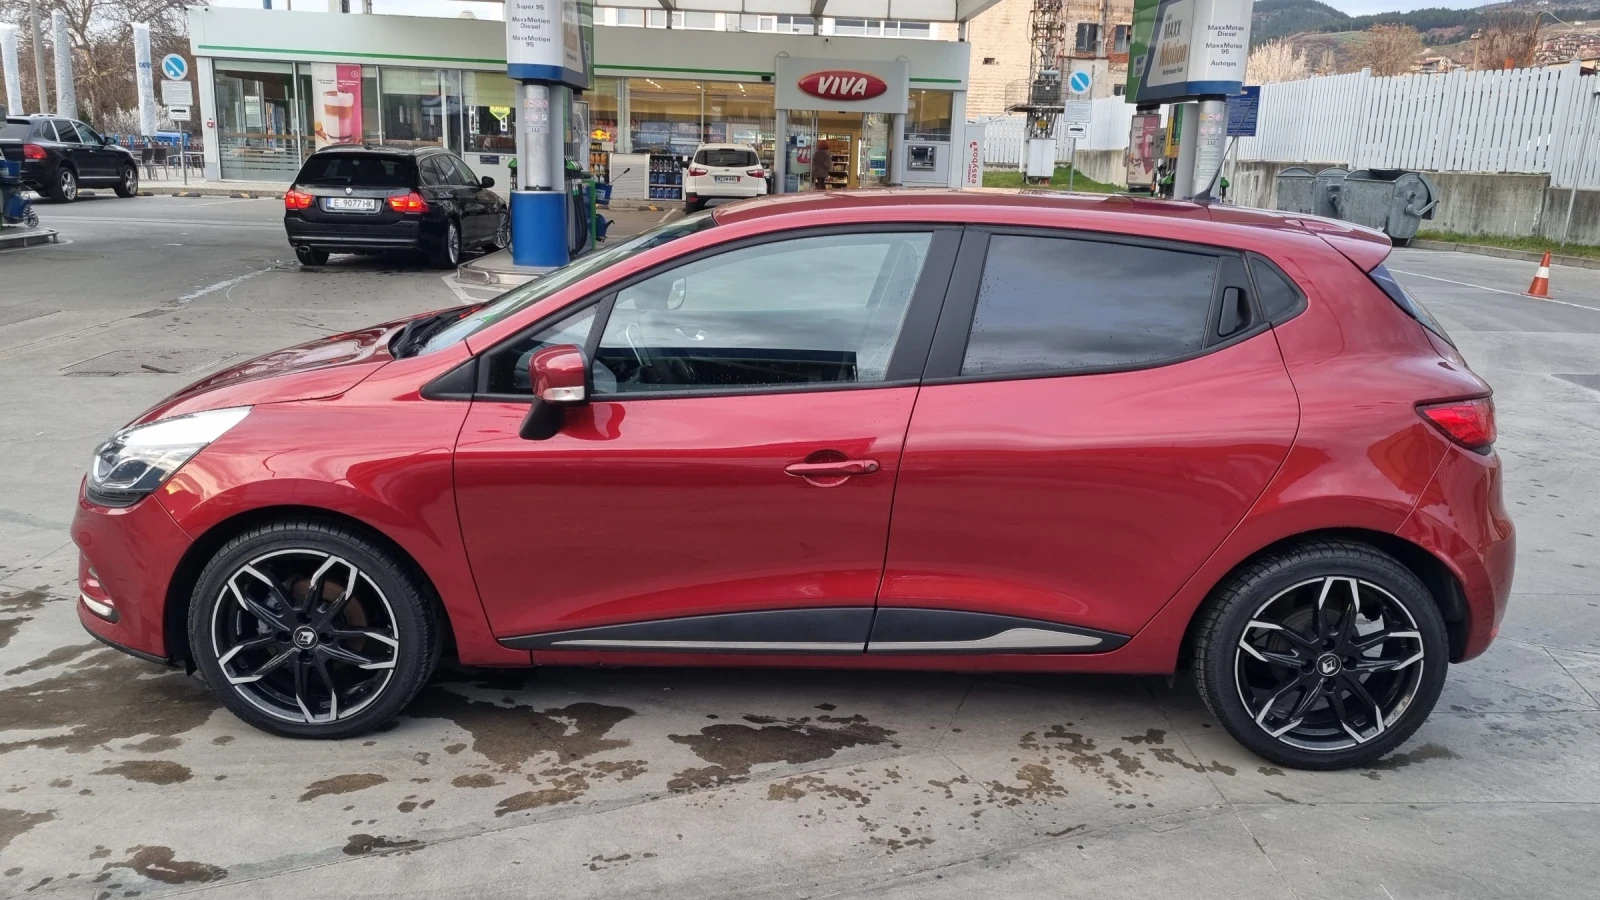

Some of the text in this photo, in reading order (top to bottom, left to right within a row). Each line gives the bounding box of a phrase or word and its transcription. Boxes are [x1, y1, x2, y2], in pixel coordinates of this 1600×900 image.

[512, 16, 551, 25] MaxxMotion
[520, 22, 541, 30] Diesel
[512, 35, 551, 43] MaxxMotion
[1159, 39, 1188, 68] Motion
[817, 75, 868, 96] VIVA
[971, 147, 979, 184] easybox
[334, 199, 339, 207] E
[343, 199, 362, 208] 9077
